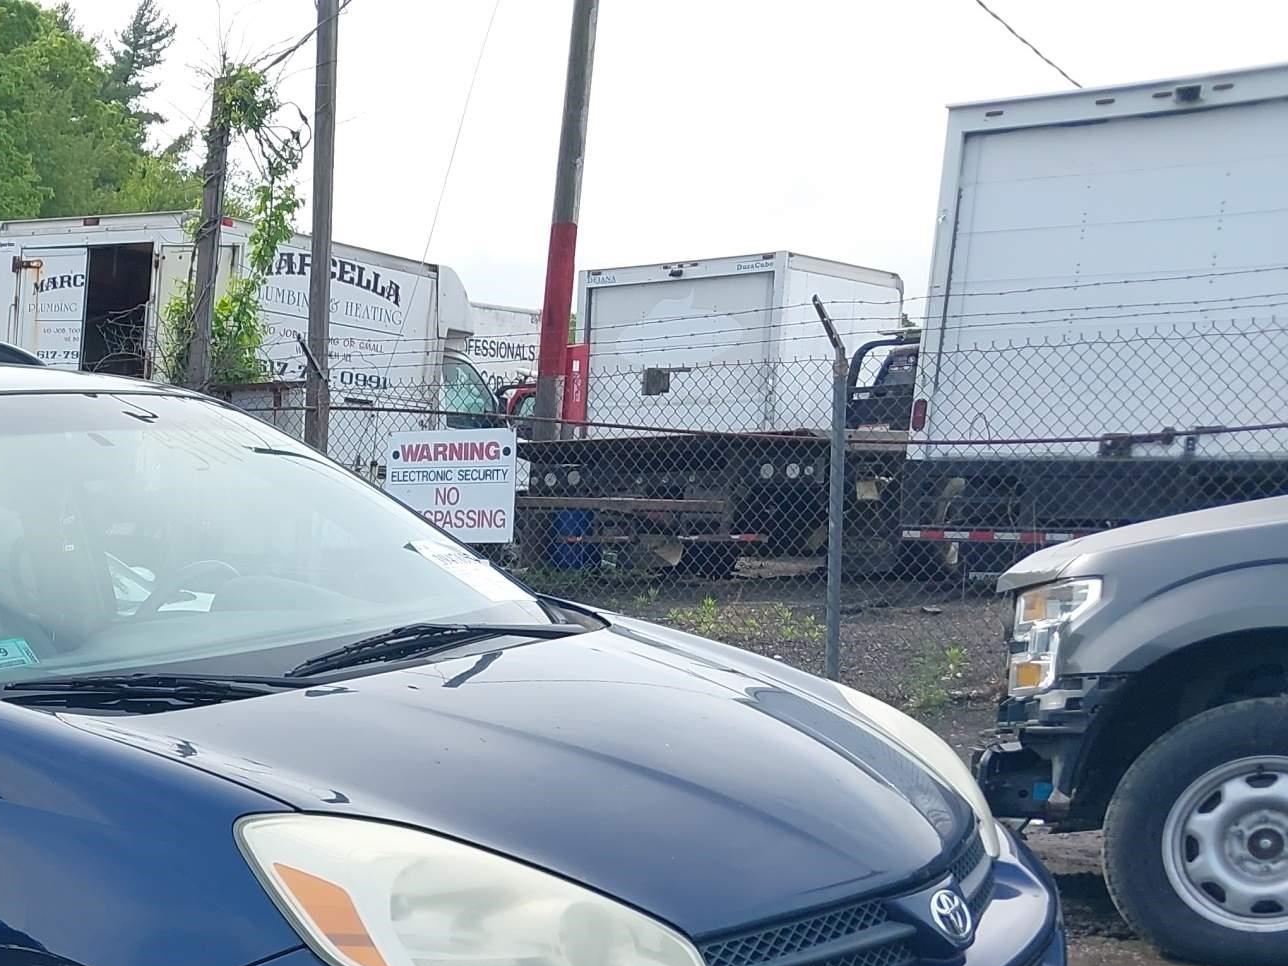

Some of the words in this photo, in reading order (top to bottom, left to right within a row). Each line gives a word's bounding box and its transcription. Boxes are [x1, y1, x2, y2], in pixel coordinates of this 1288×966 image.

[265, 252, 401, 307] ARELLA
[258, 286, 310, 306] LUMBIN
[344, 301, 402, 325] HEATING
[400, 441, 501, 462] WARNING
[392, 470, 453, 482] ELECTRONIC
[457, 468, 509, 481] SECURITY
[435, 487, 460, 506] NO
[419, 509, 506, 529] SPASSING
